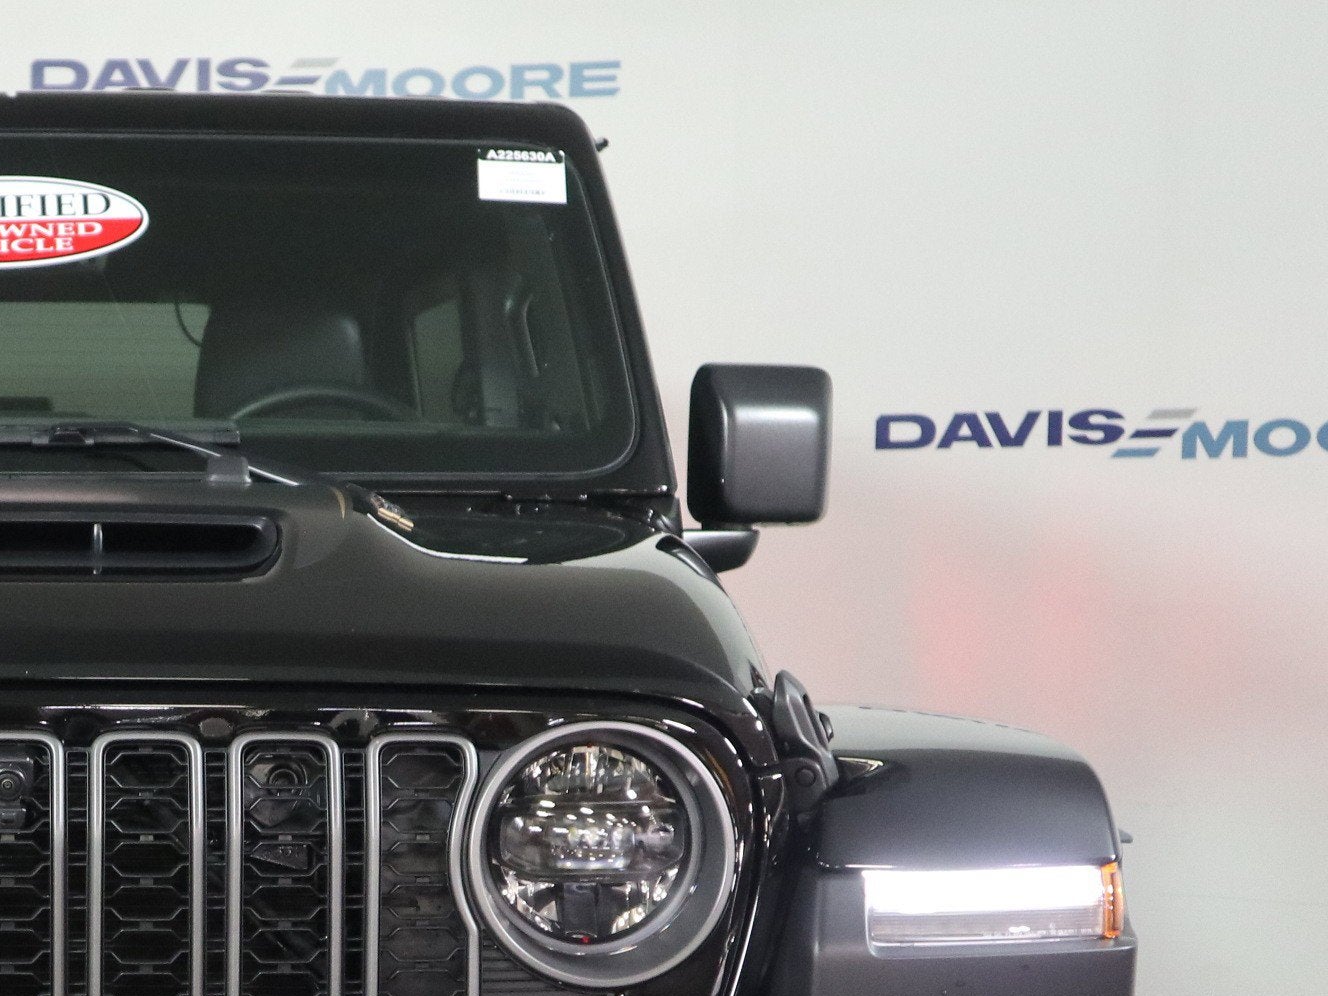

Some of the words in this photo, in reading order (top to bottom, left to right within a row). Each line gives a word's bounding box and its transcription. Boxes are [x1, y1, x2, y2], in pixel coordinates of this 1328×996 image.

[30, 58, 270, 92] DAVIS
[324, 60, 621, 100] MOORE
[875, 408, 1126, 450] DAVIS
[1181, 417, 1328, 460] MO
